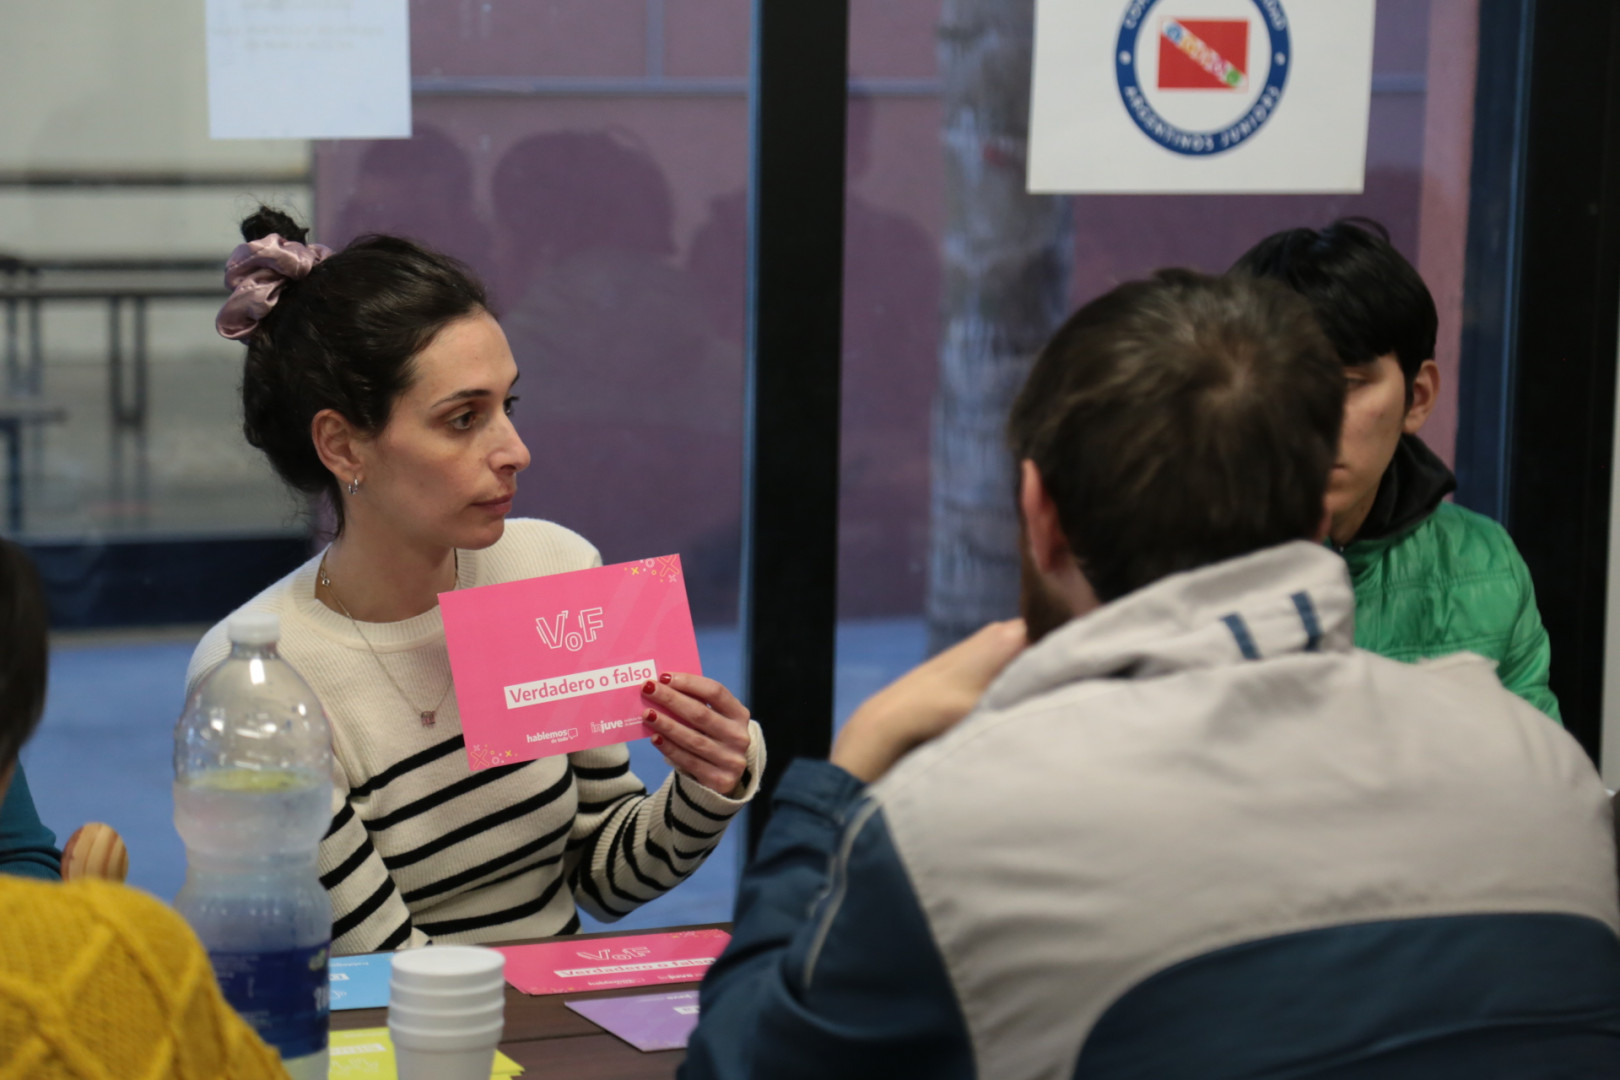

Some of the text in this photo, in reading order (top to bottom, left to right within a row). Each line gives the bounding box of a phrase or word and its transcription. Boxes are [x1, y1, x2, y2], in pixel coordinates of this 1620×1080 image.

[1124, 86, 1280, 152] ARGENTINOS JUNIORS
[536, 607, 603, 651] VoF
[510, 666, 652, 703] Verdadero o falso
[526, 729, 568, 743] hablemos
[576, 946, 651, 961] VoF
[562, 962, 652, 976] Verdadero
